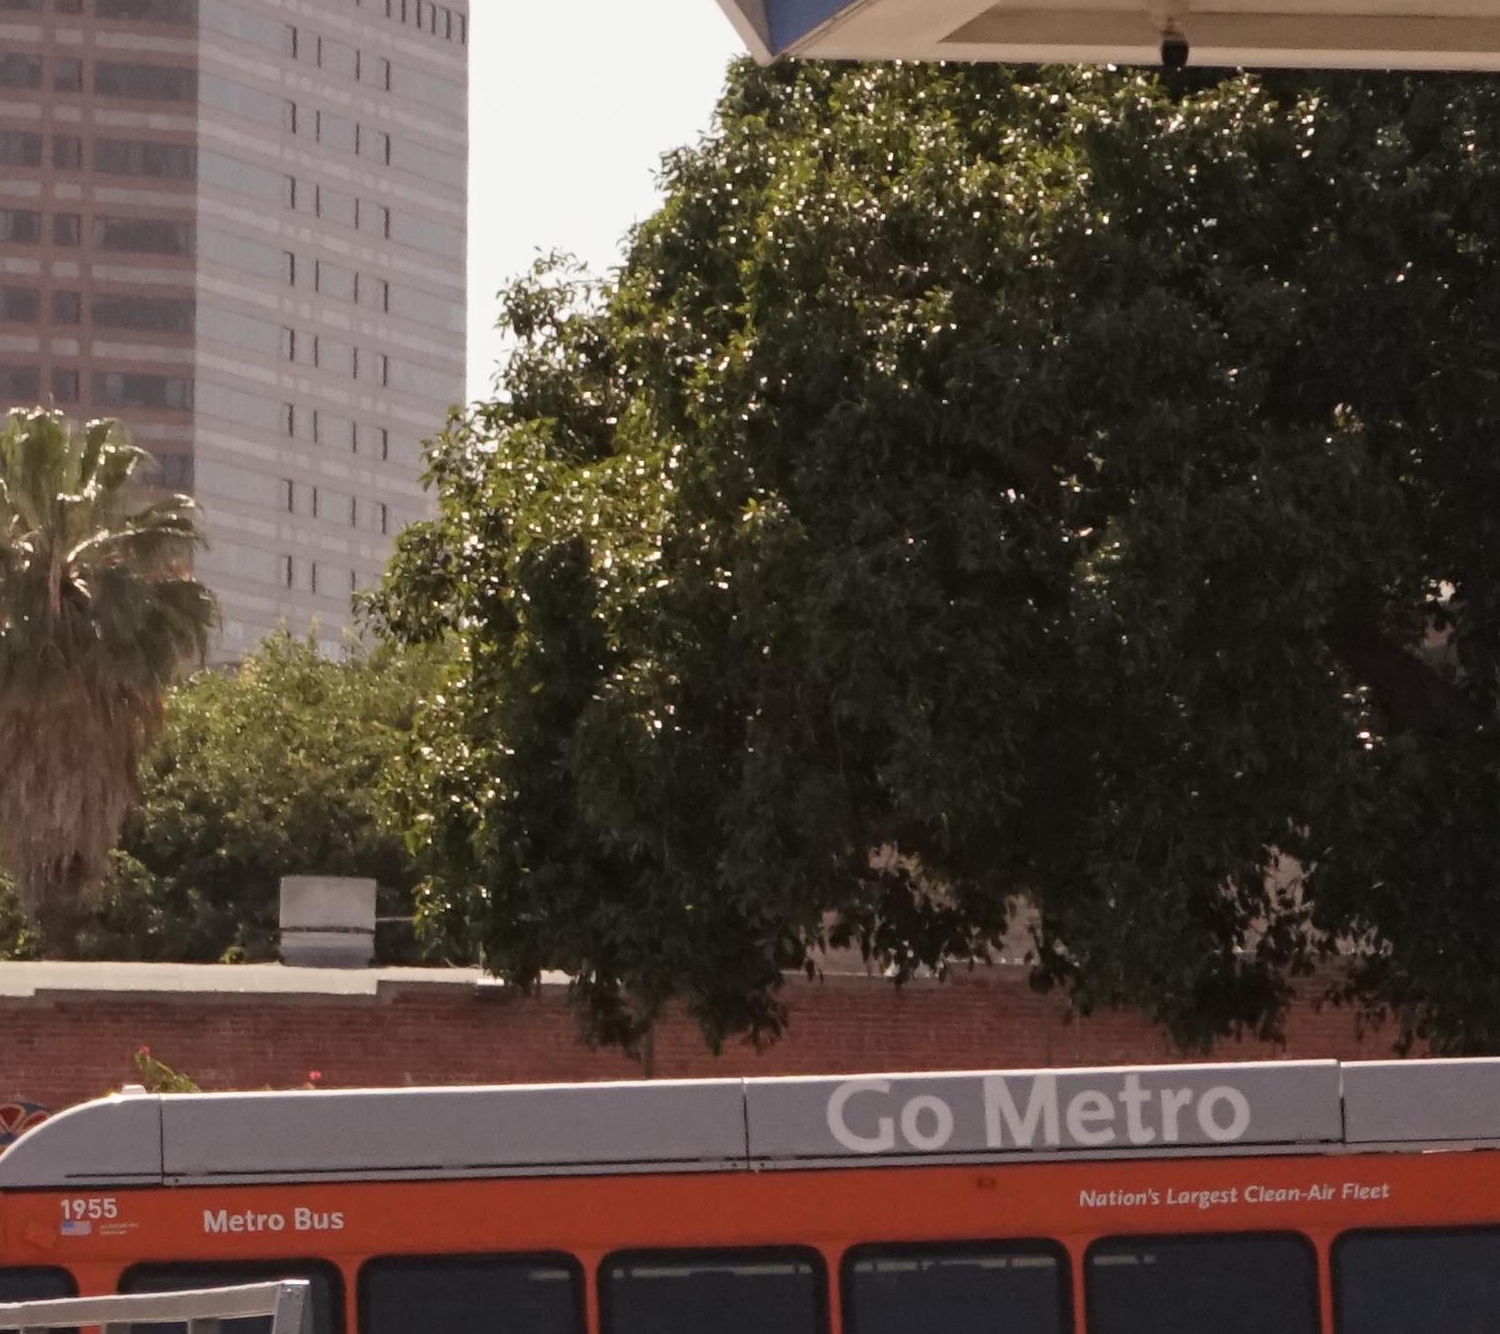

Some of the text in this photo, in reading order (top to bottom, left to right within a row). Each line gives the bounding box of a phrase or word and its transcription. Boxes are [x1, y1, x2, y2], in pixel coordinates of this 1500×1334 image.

[825, 1073, 1252, 1154] Go Metro
[60, 1198, 118, 1220] 1955
[1078, 1182, 1391, 1210] Nation's Largest Clean-Air Fleet
[202, 1206, 345, 1234] Metro Bus
